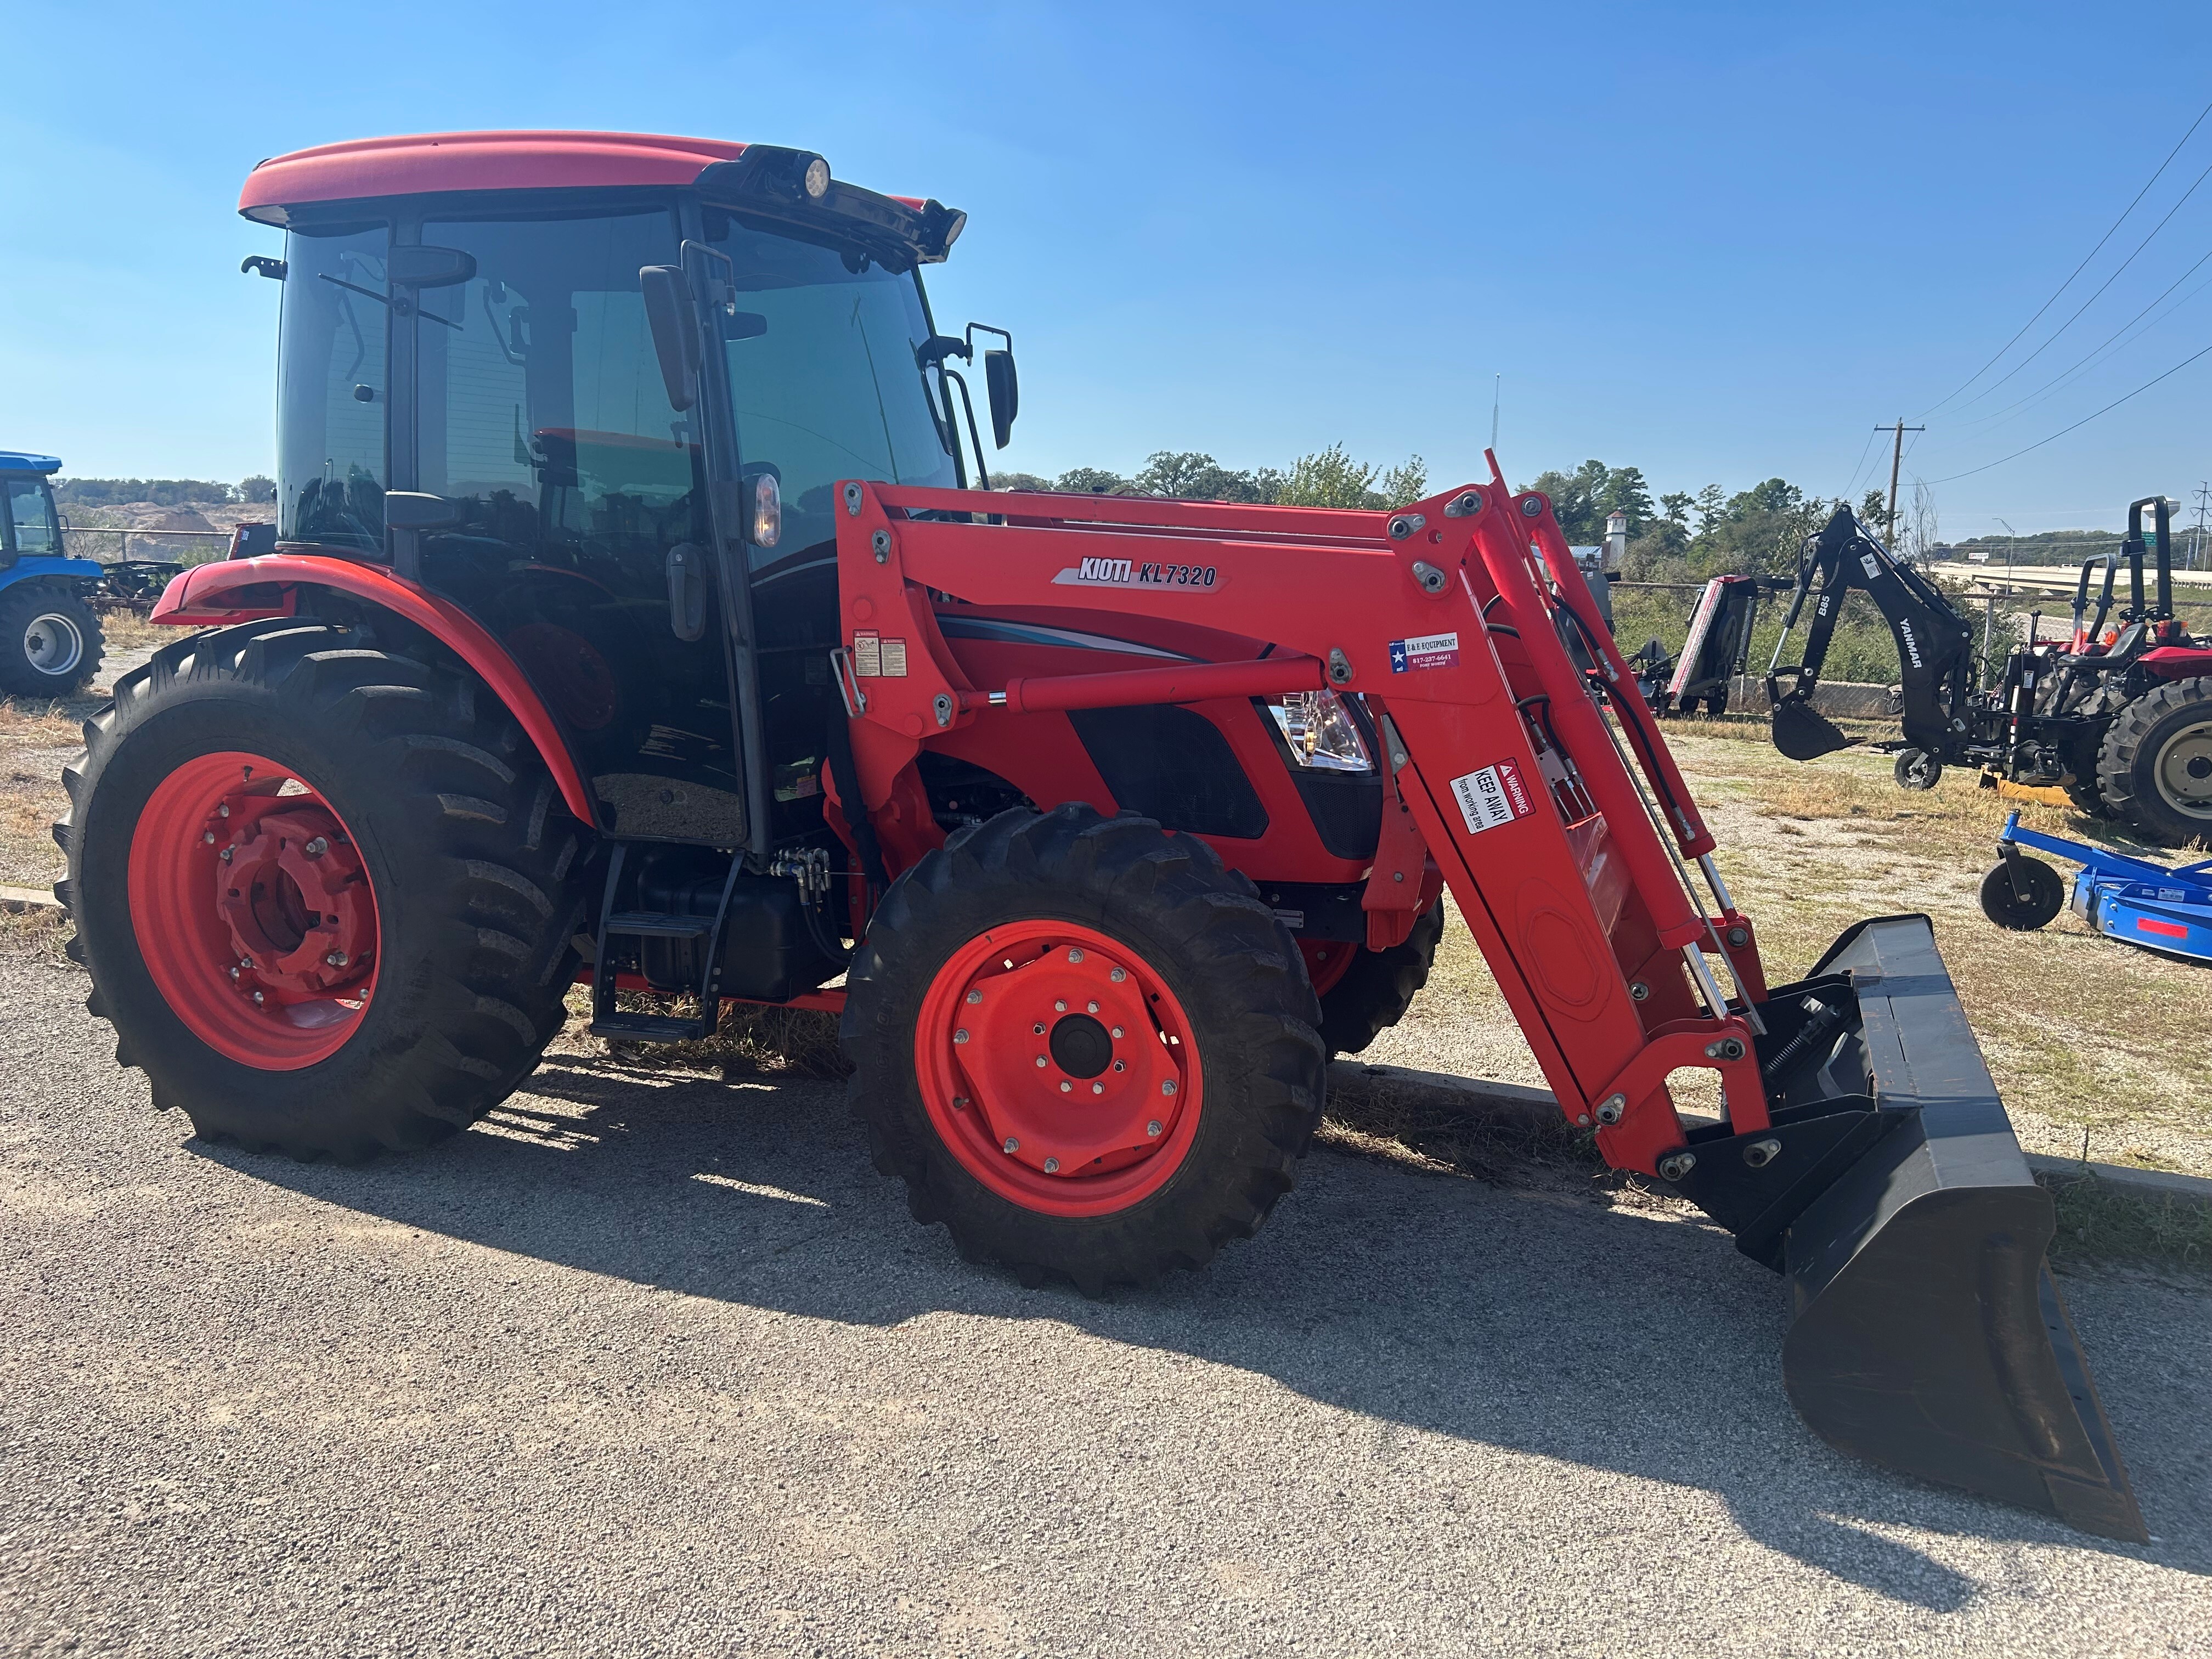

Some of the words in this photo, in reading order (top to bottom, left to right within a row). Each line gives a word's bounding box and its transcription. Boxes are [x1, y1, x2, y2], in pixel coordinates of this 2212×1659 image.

[1077, 557, 1132, 583] KIOTI
[1138, 562, 1217, 586] KL7320
[1818, 595, 1830, 617] B85
[1421, 638, 1455, 651] EQUIPMENT
[1900, 618, 1922, 668] YANMAR
[1413, 654, 1451, 664] 817-237-6641
[1475, 770, 1497, 793] KEEP
[1506, 774, 1529, 814] WARNING
[1458, 778, 1470, 793] from
[1464, 793, 1479, 817] working
[1472, 816, 1484, 830] area
[1485, 795, 1508, 821] AWAY
